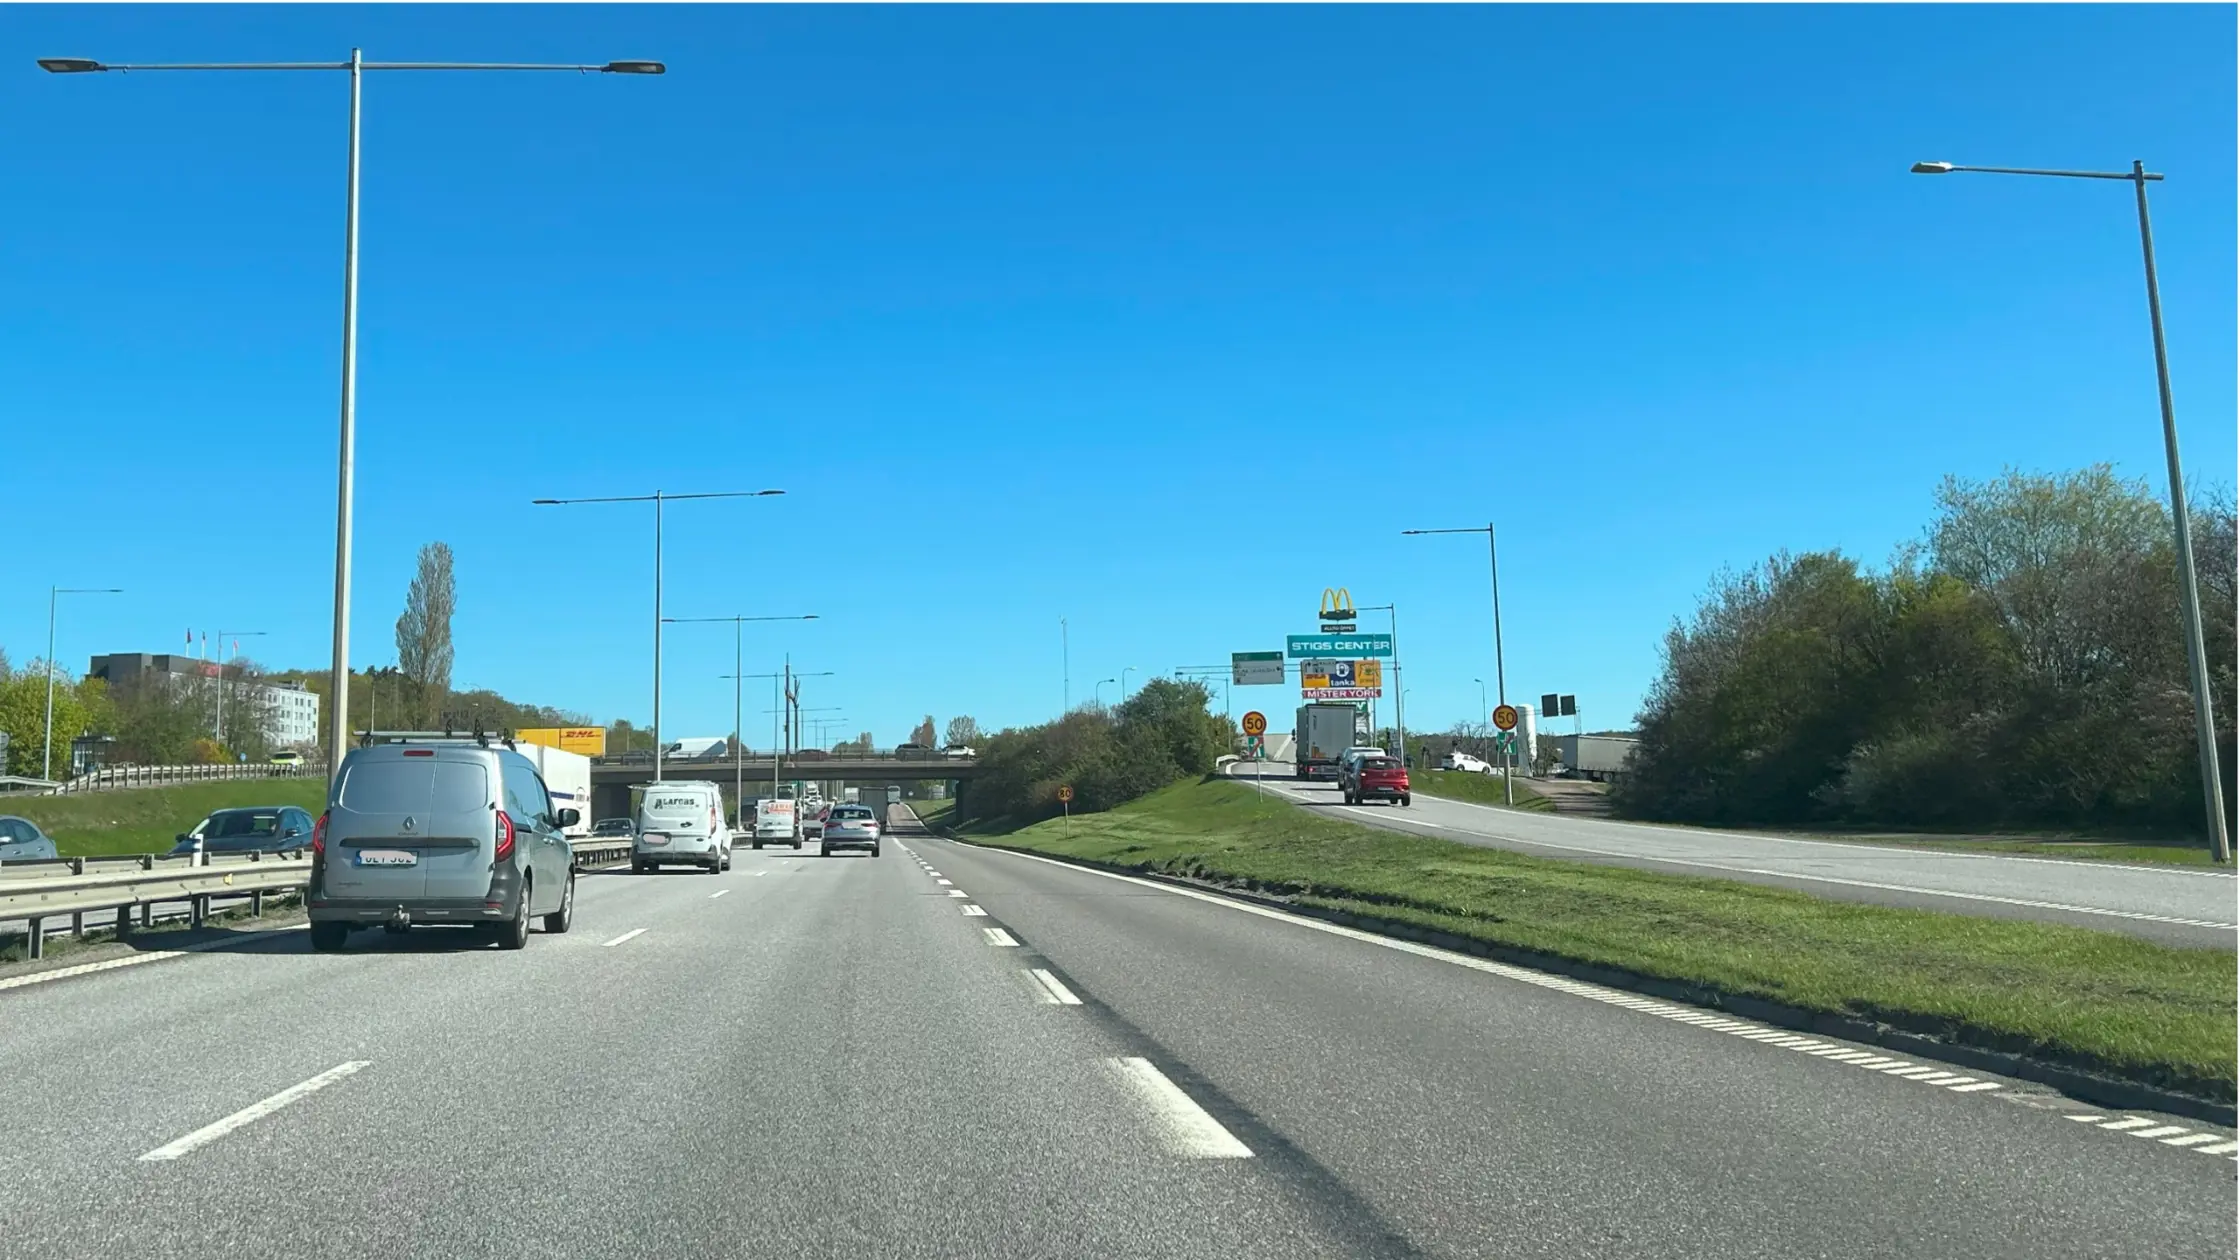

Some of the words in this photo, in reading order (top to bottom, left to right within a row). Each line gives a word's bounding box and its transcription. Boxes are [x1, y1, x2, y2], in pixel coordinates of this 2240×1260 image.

[1292, 641, 1332, 651] STIGS
[1334, 641, 1390, 651] CENTER
[1331, 679, 1355, 687] tanka
[1307, 690, 1345, 698] MISTER
[1348, 690, 1378, 698] YORK
[1498, 711, 1514, 725] 50
[1246, 718, 1263, 730] 50
